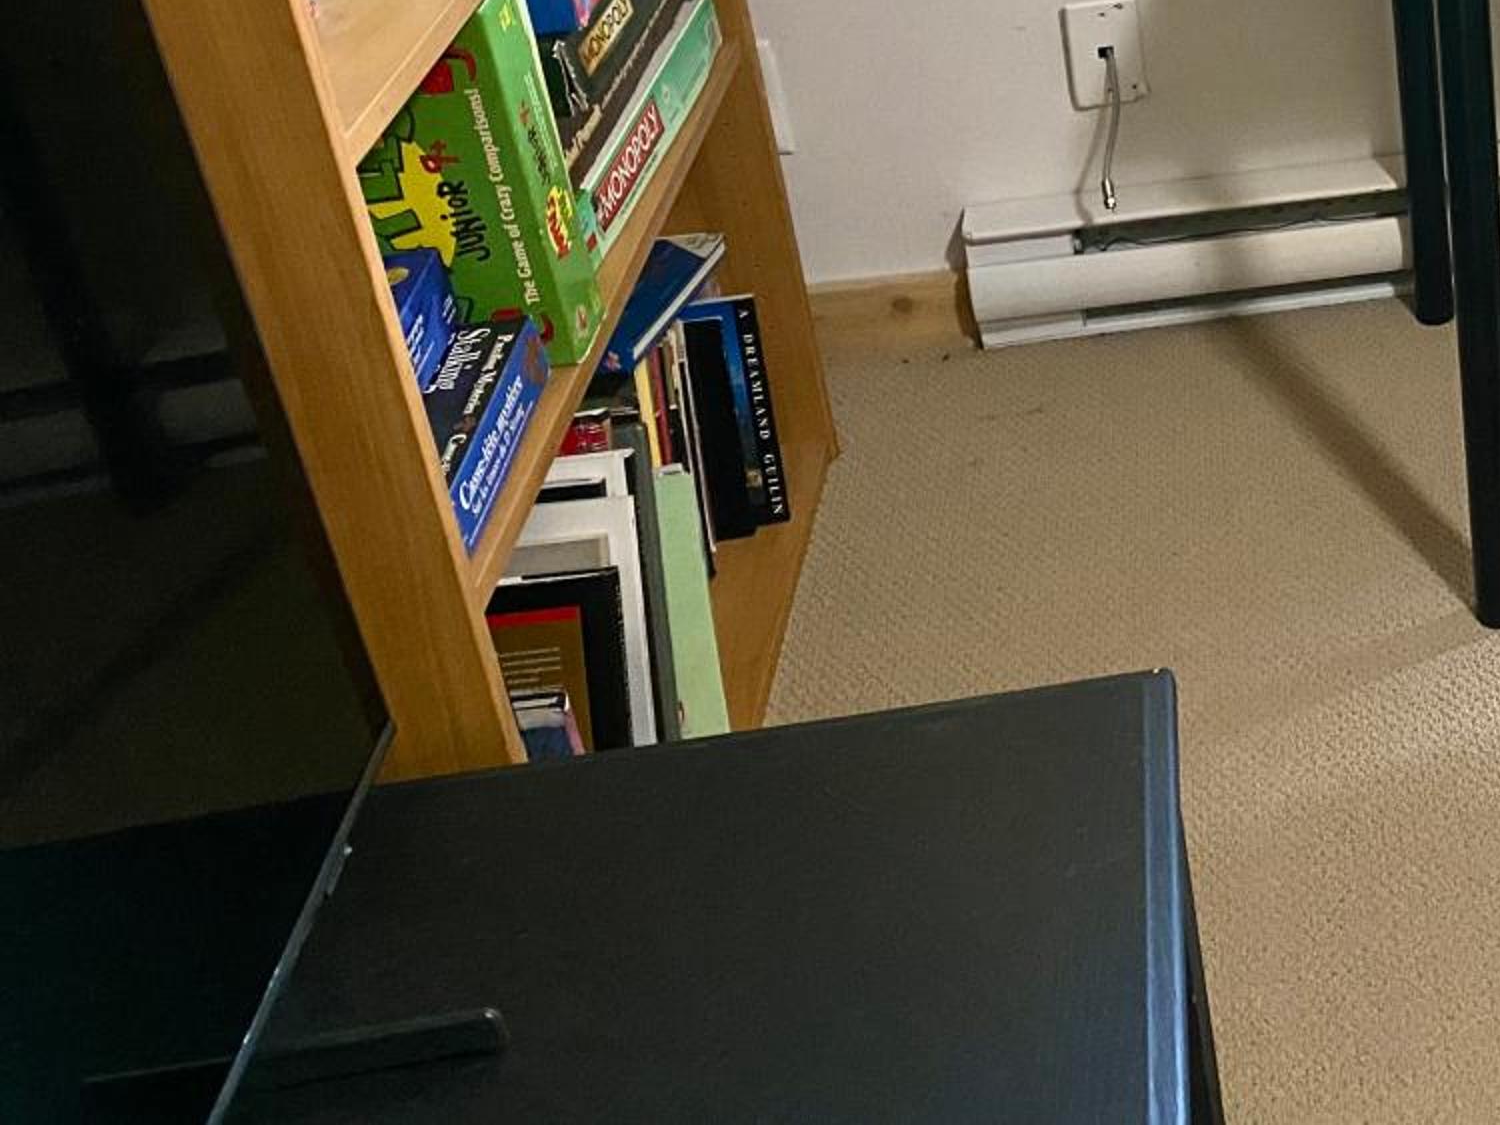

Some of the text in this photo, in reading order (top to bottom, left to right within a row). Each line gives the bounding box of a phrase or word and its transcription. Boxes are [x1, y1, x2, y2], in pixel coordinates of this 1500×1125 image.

[467, 87, 541, 305] The Game of Crazy Comparisons!
[599, 110, 661, 220] MONOPOLY
[738, 308, 783, 515] A DREAMLAND GUILIN
